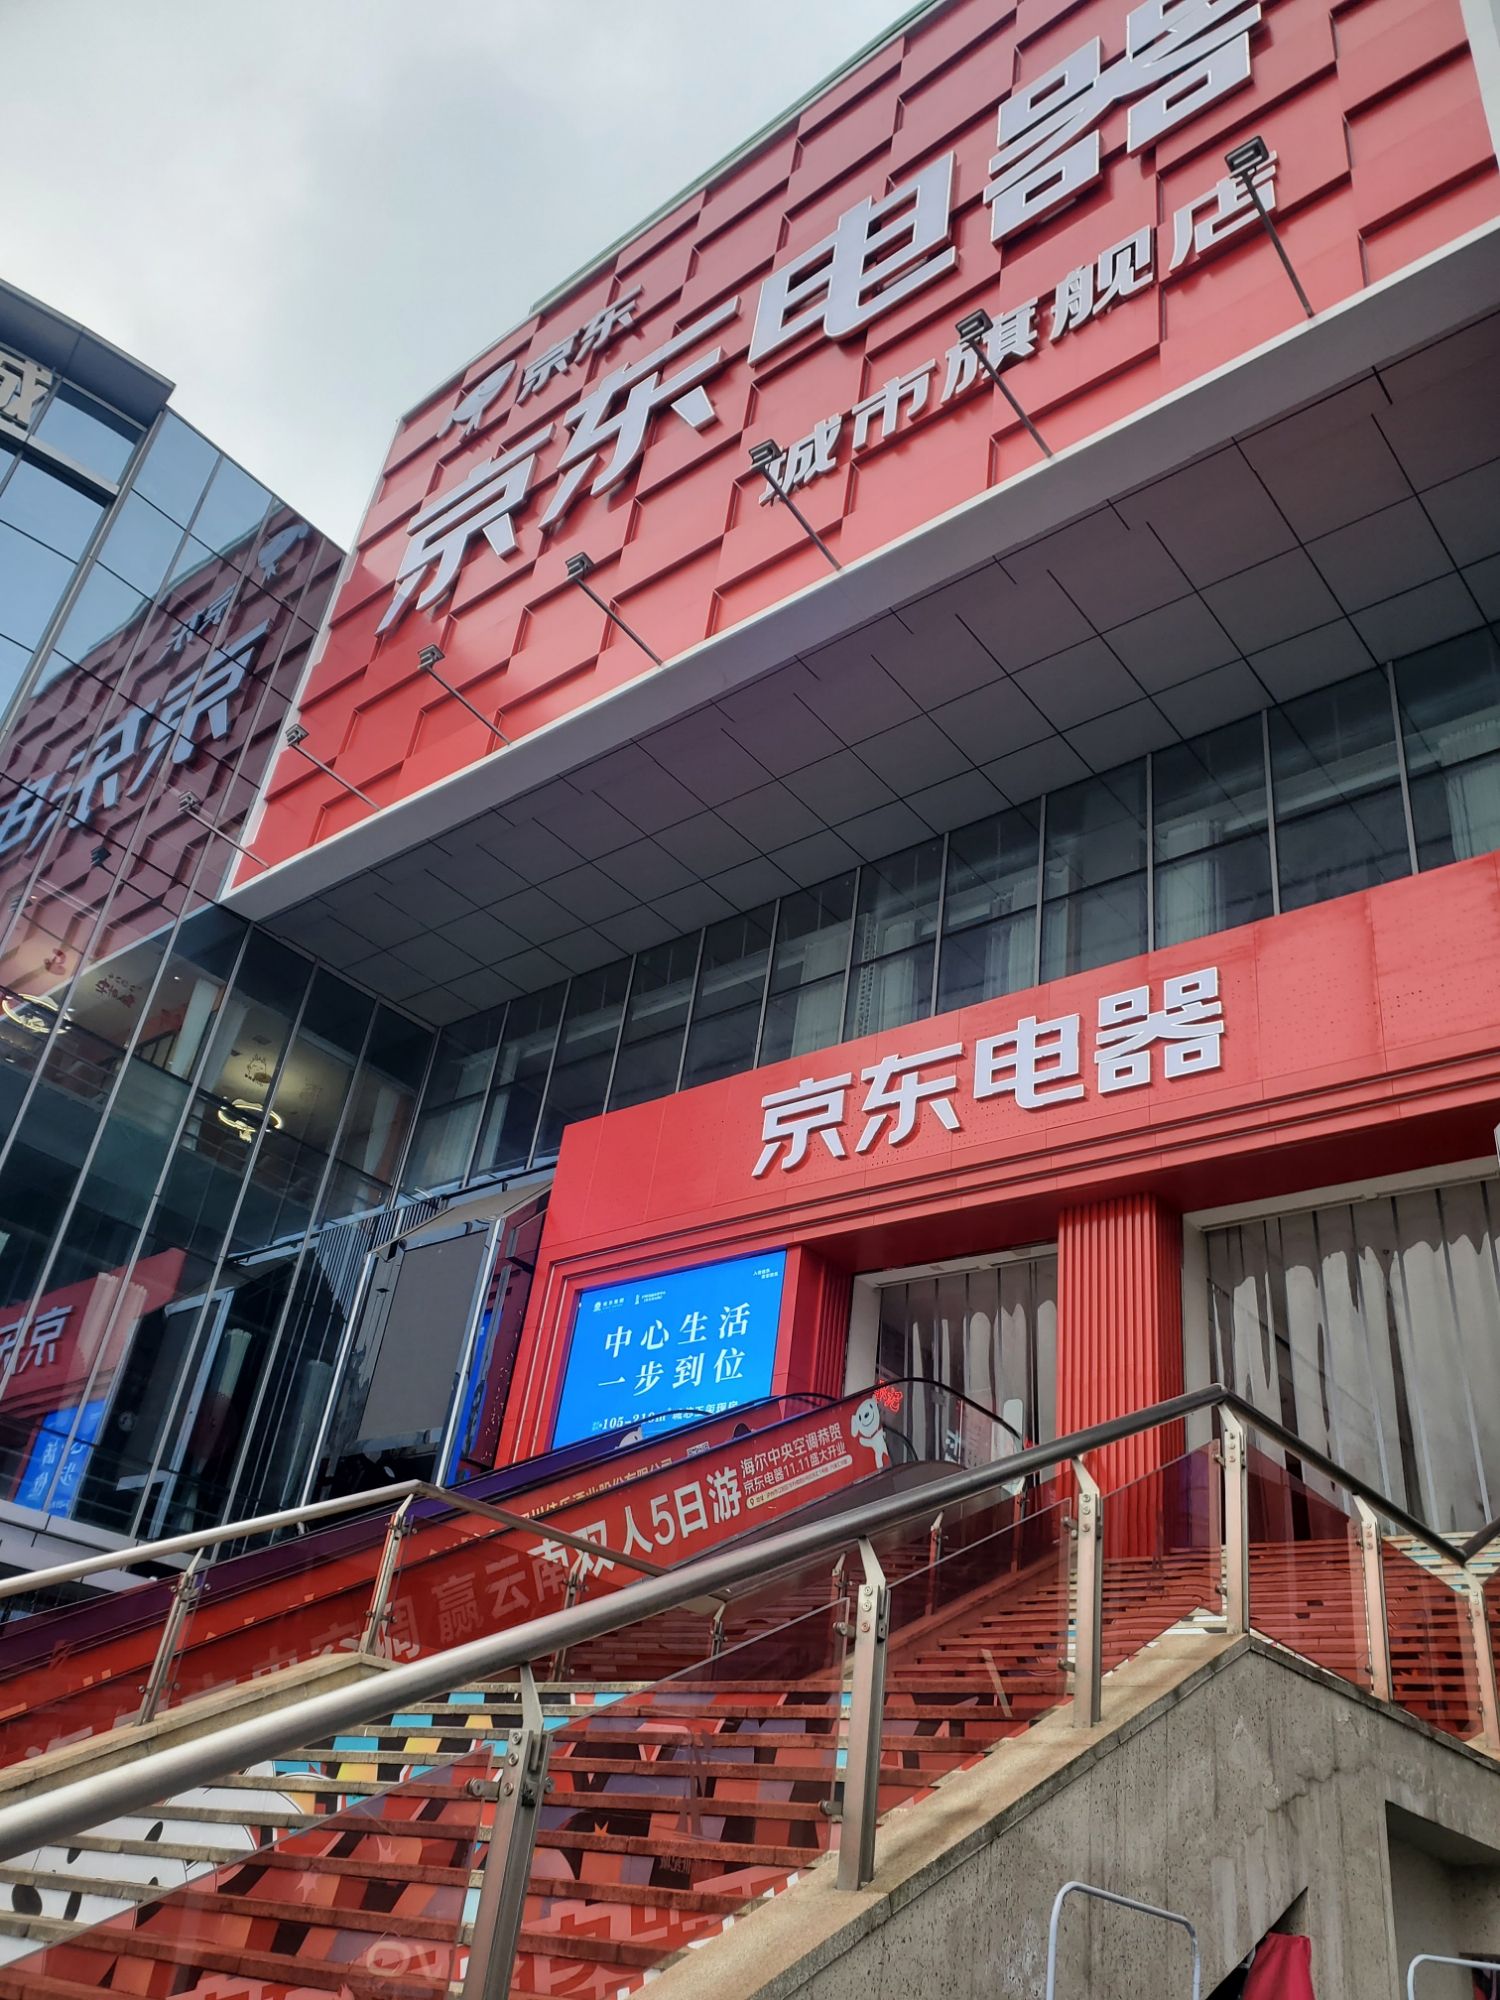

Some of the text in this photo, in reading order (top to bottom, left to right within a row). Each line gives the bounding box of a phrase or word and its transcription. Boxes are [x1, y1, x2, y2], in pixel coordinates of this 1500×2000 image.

[375, 0, 1261, 636] 京东电器
[516, 284, 645, 405] 京东
[758, 150, 1277, 505] 城市旗舰店
[751, 966, 1224, 1178] 京东电器
[598, 1347, 746, 1396] 一步到位
[605, 1302, 751, 1359] 中心生活
[740, 1422, 843, 1479] 海尔中央空调恭贺
[743, 1441, 847, 1496] 京东电器11.11盛大开业
